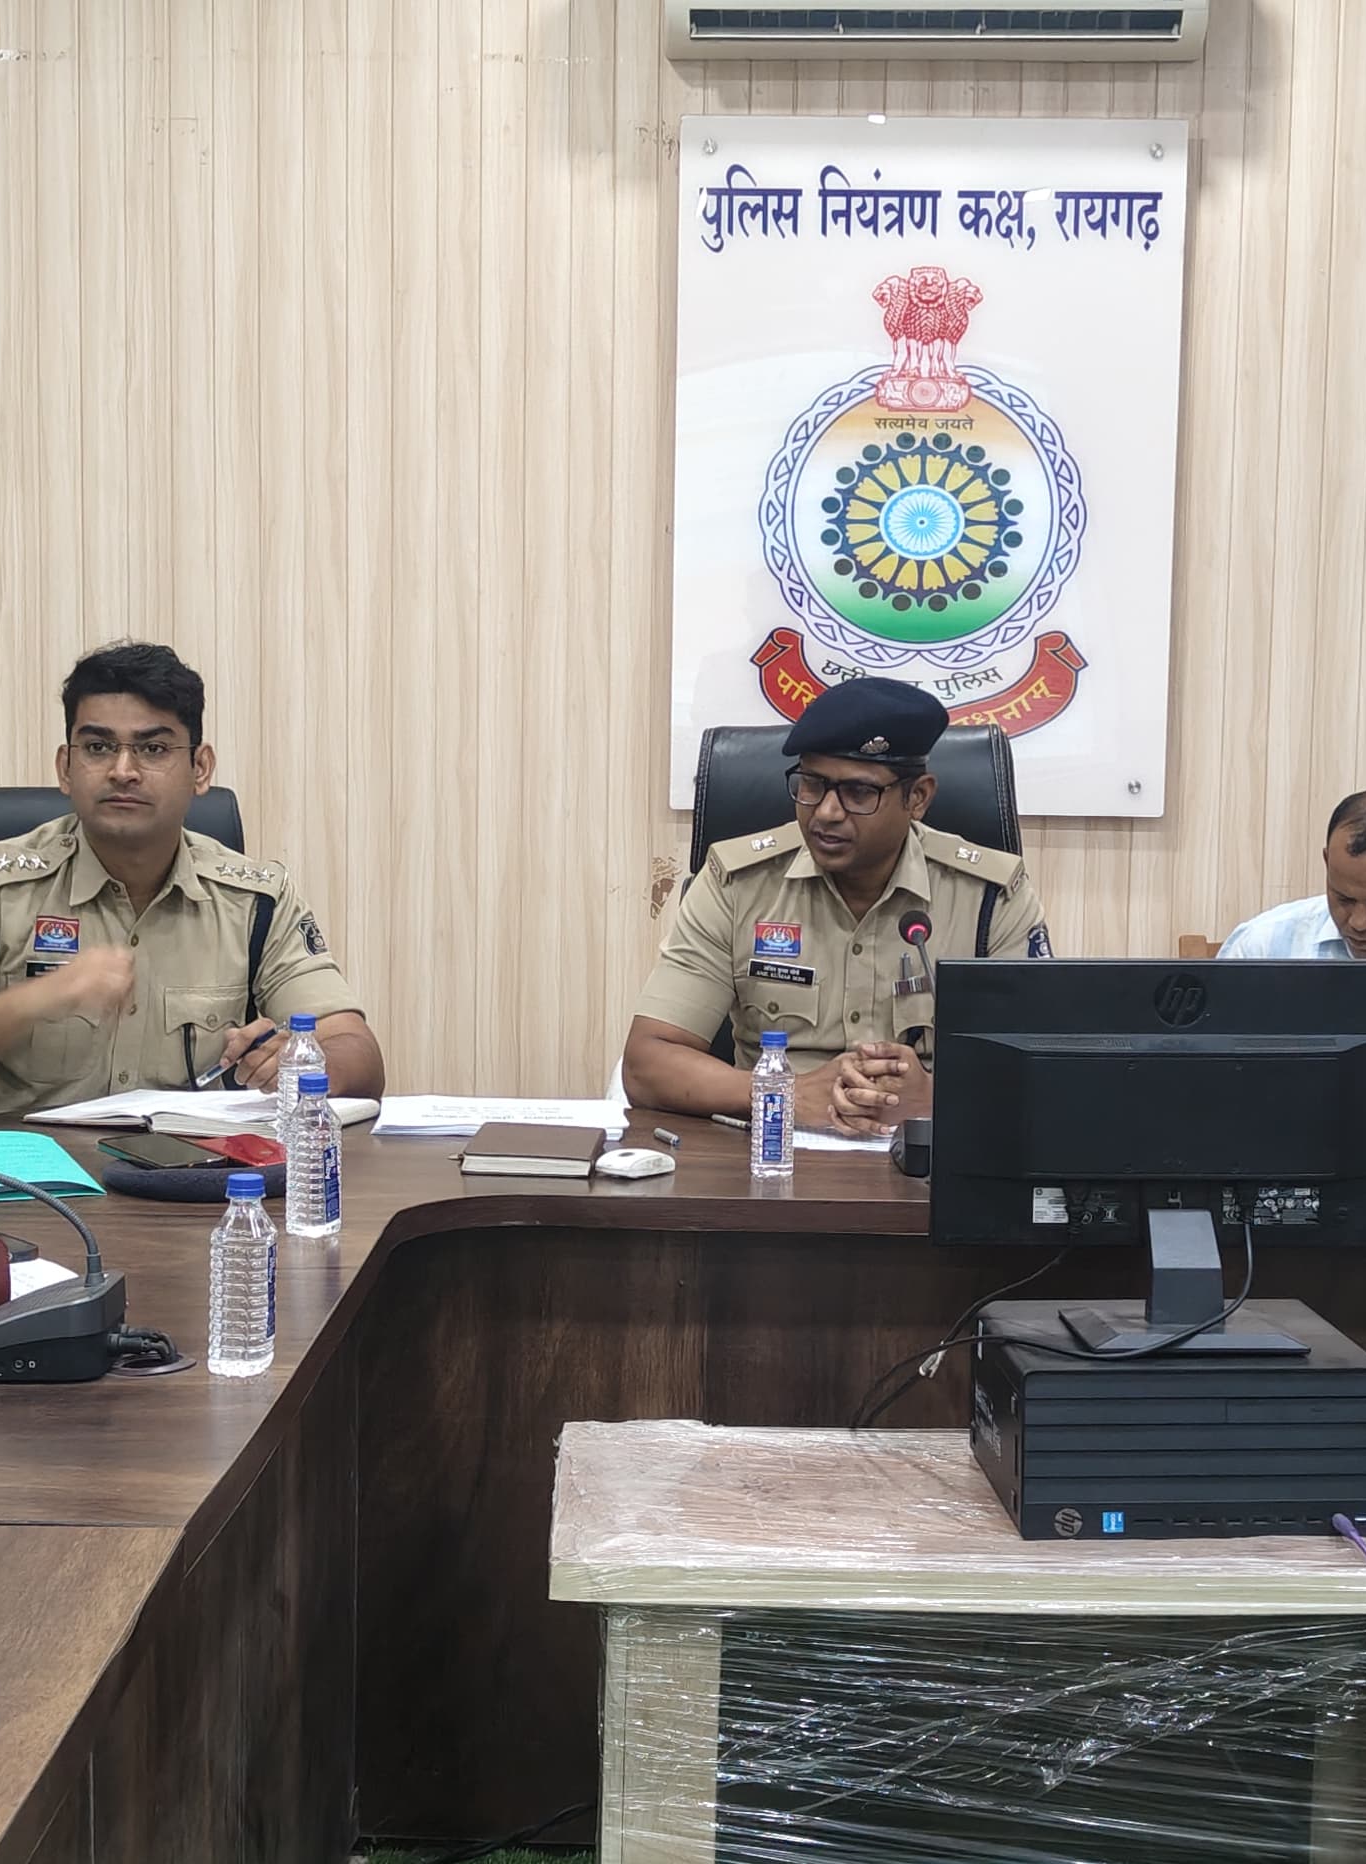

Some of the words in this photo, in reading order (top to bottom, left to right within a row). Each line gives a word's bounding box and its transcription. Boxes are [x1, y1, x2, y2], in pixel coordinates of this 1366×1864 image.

[699, 164, 802, 252] पुलिस
[819, 164, 941, 239] नियंत्रण
[958, 189, 1037, 250] कक्ष,
[1054, 191, 1162, 251] रायगढ़
[874, 414, 930, 430] सत्यमेव
[935, 414, 975, 431] जयते
[934, 666, 1003, 700] पुलिस
